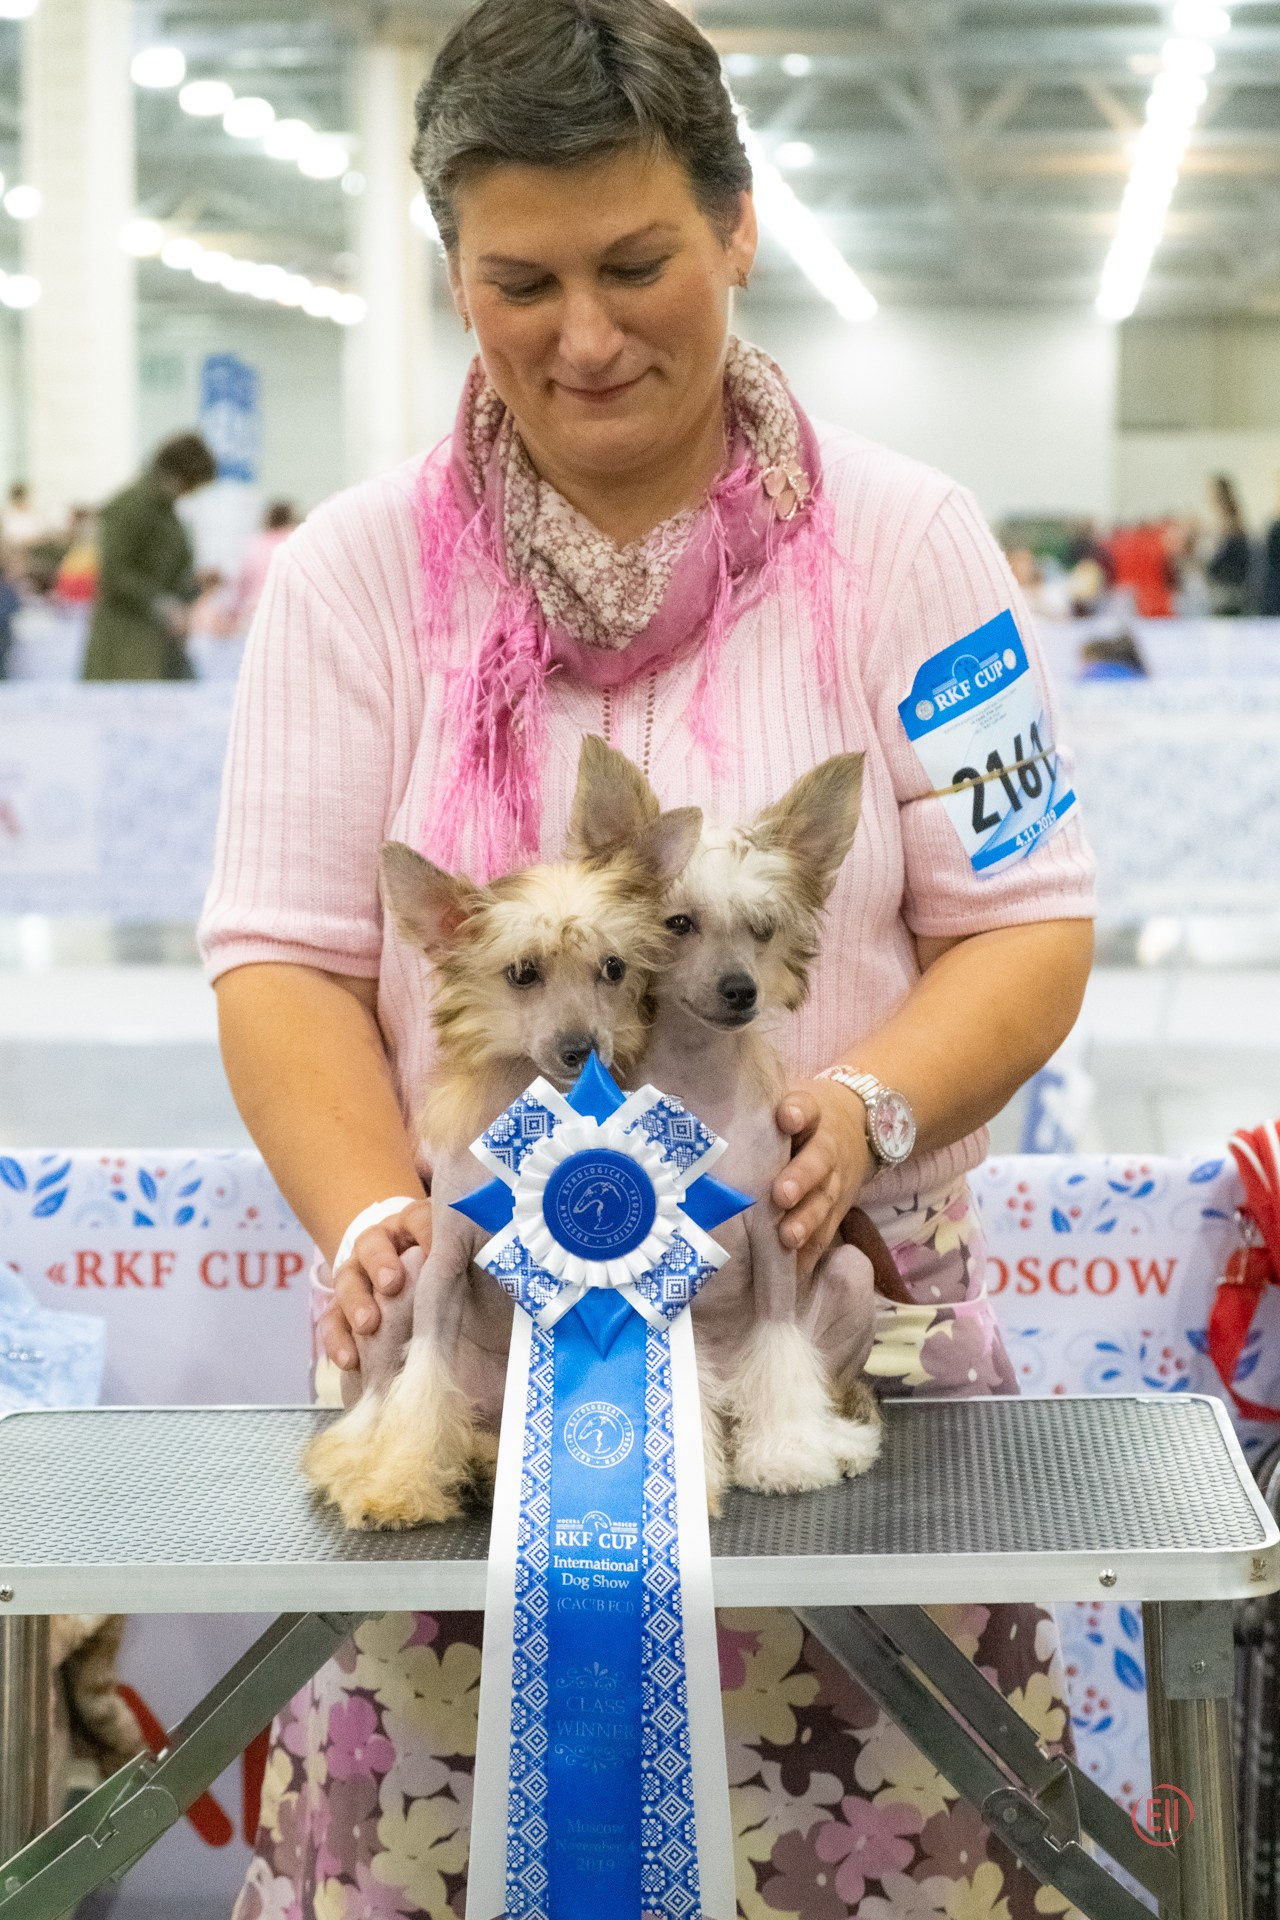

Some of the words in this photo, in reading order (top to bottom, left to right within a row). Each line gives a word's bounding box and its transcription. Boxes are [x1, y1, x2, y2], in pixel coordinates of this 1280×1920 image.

[933, 680, 971, 712] RKF
[974, 660, 1004, 689] CUP
[952, 721, 1057, 834] 2161
[1015, 809, 1057, 848] 4.11.2019
[563, 1167, 627, 1195] KYNOLOGICAL
[560, 1205, 590, 1244] RUSSIAN
[606, 1189, 640, 1244] FEDERATION
[198, 1250, 305, 1290] CUP
[555, 1530, 593, 1547] RKF
[599, 1533, 638, 1550] CUP
[553, 1555, 638, 1572] International
[562, 1573, 589, 1590] Dog
[593, 1574, 630, 1589] Show
[566, 1696, 625, 1714] CLASS
[556, 1720, 636, 1739] WINNER
[565, 1819, 624, 1834] Moscow
[576, 1857, 615, 1871] 2019
